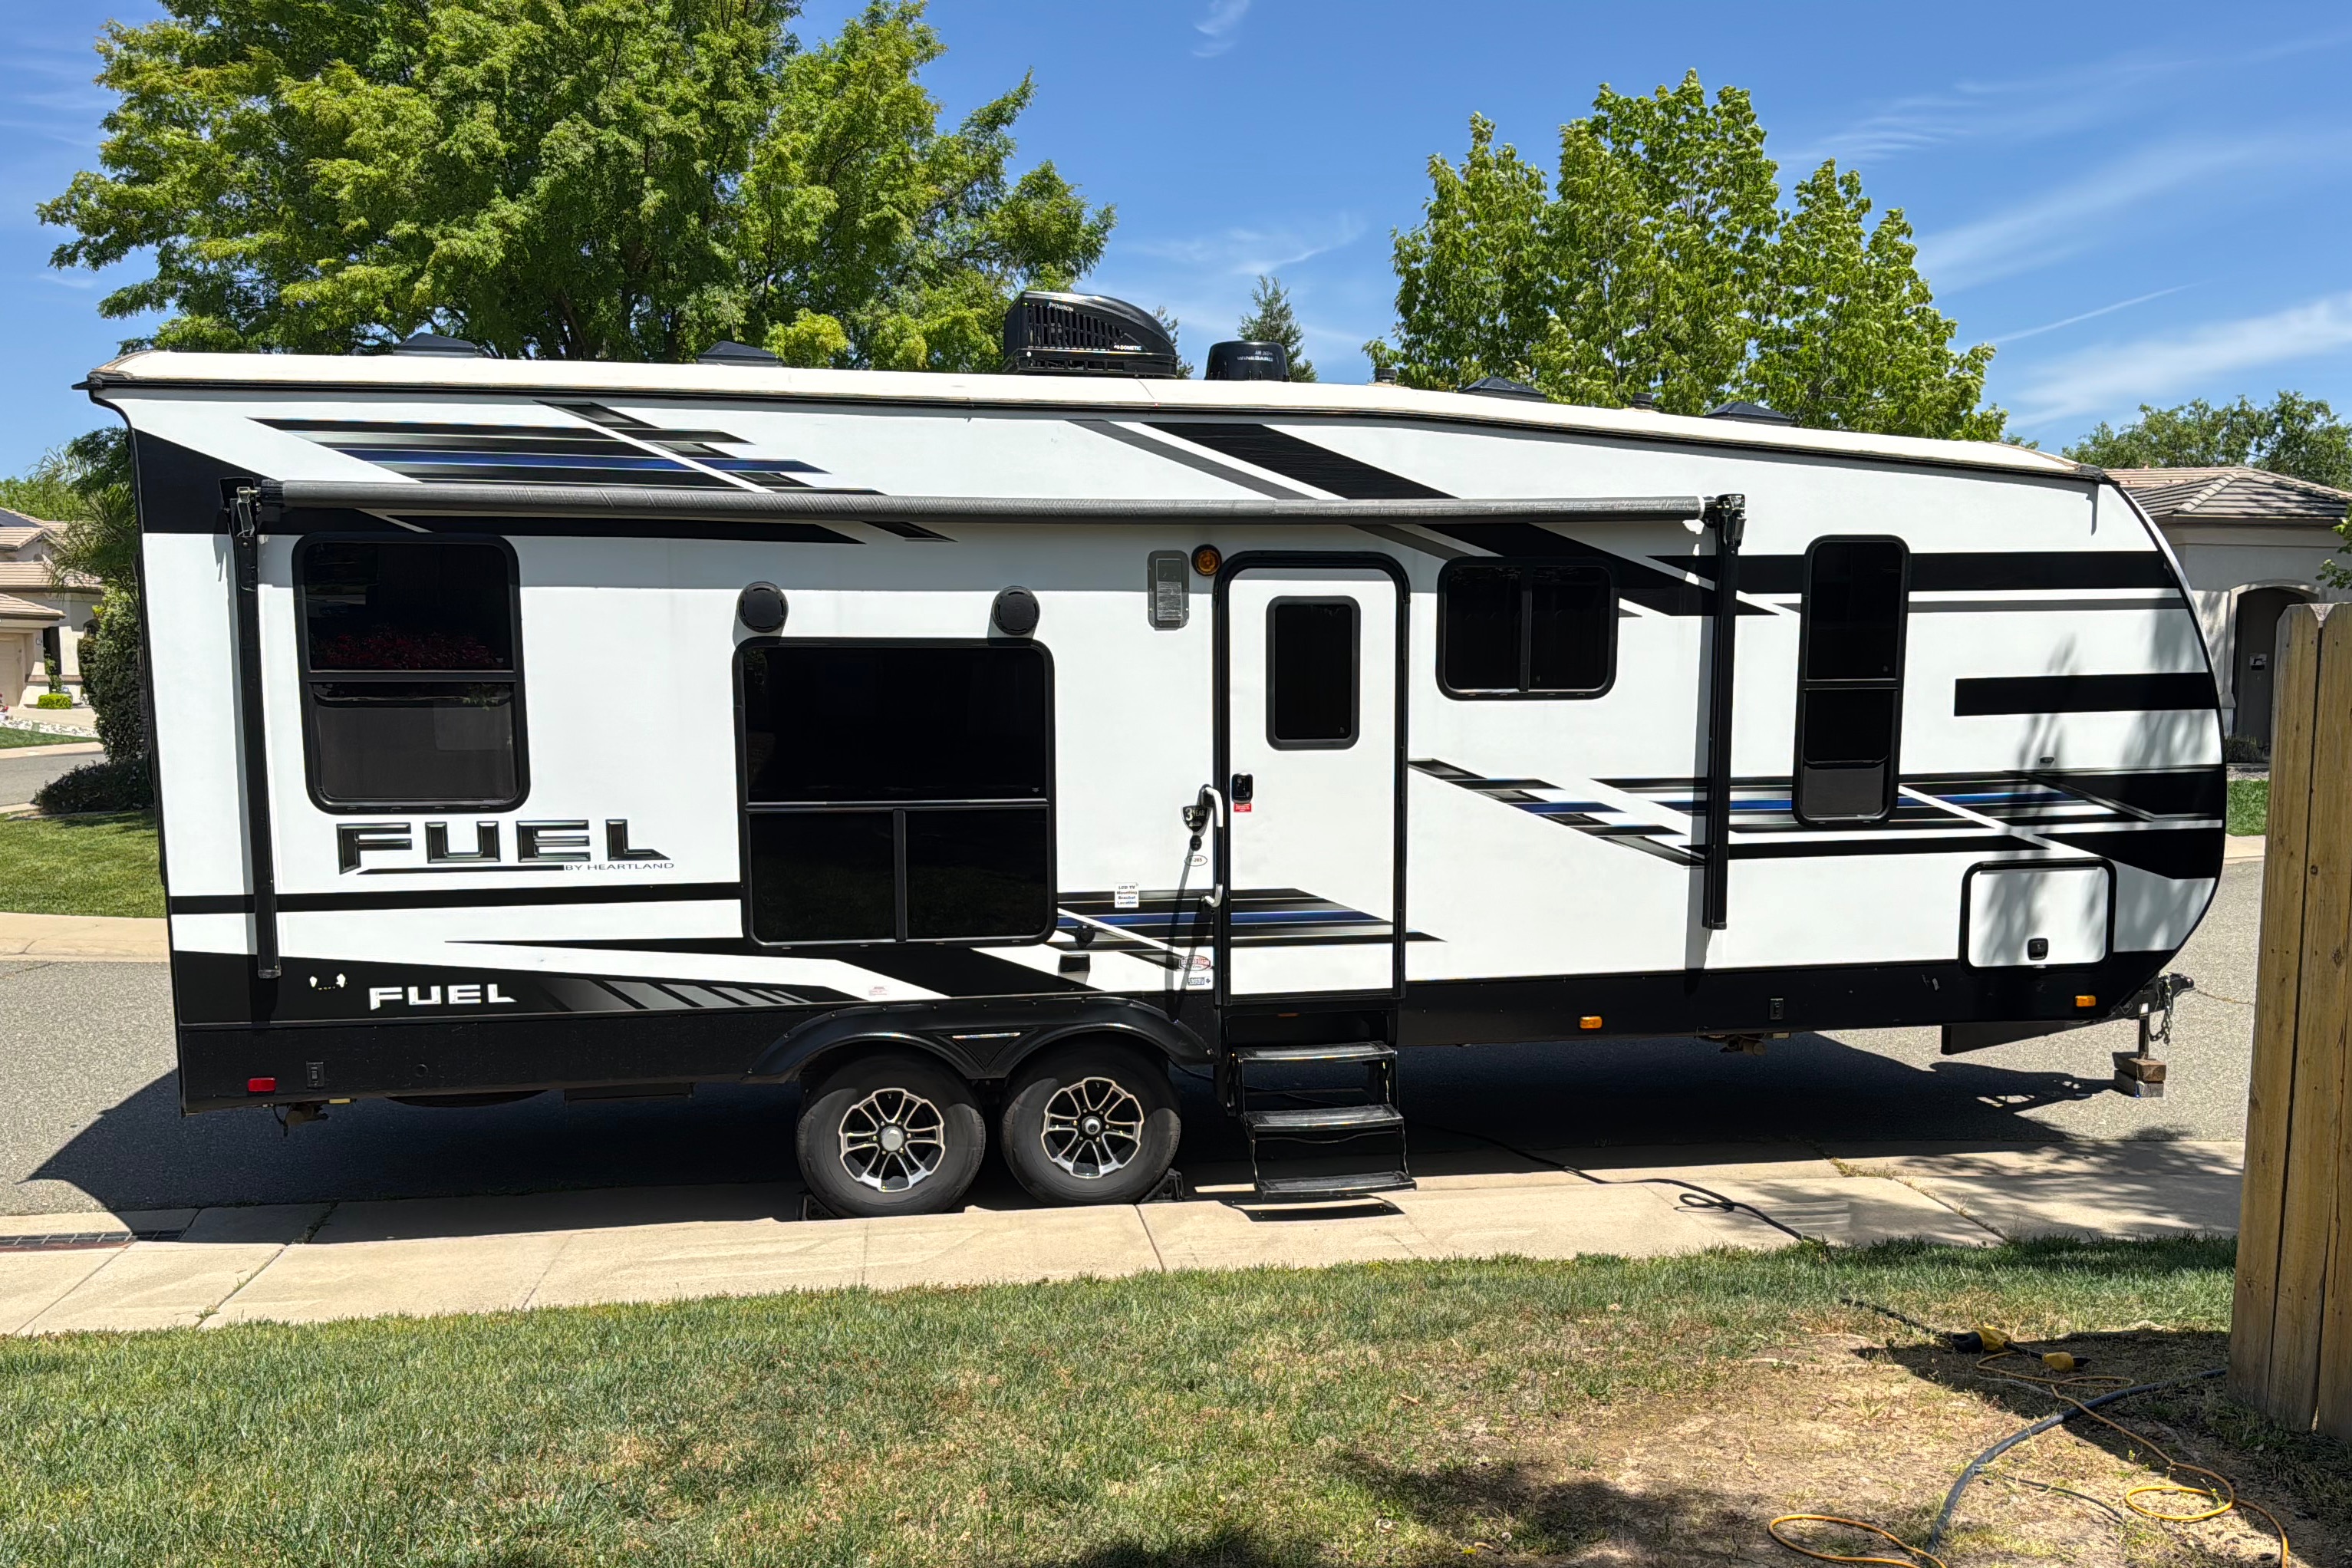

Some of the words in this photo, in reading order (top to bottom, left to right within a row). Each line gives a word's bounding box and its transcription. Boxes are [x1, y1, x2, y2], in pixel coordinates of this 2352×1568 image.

[1185, 808, 1193, 821] 3
[336, 819, 670, 875] FUEL
[369, 983, 518, 1011] FUEL
